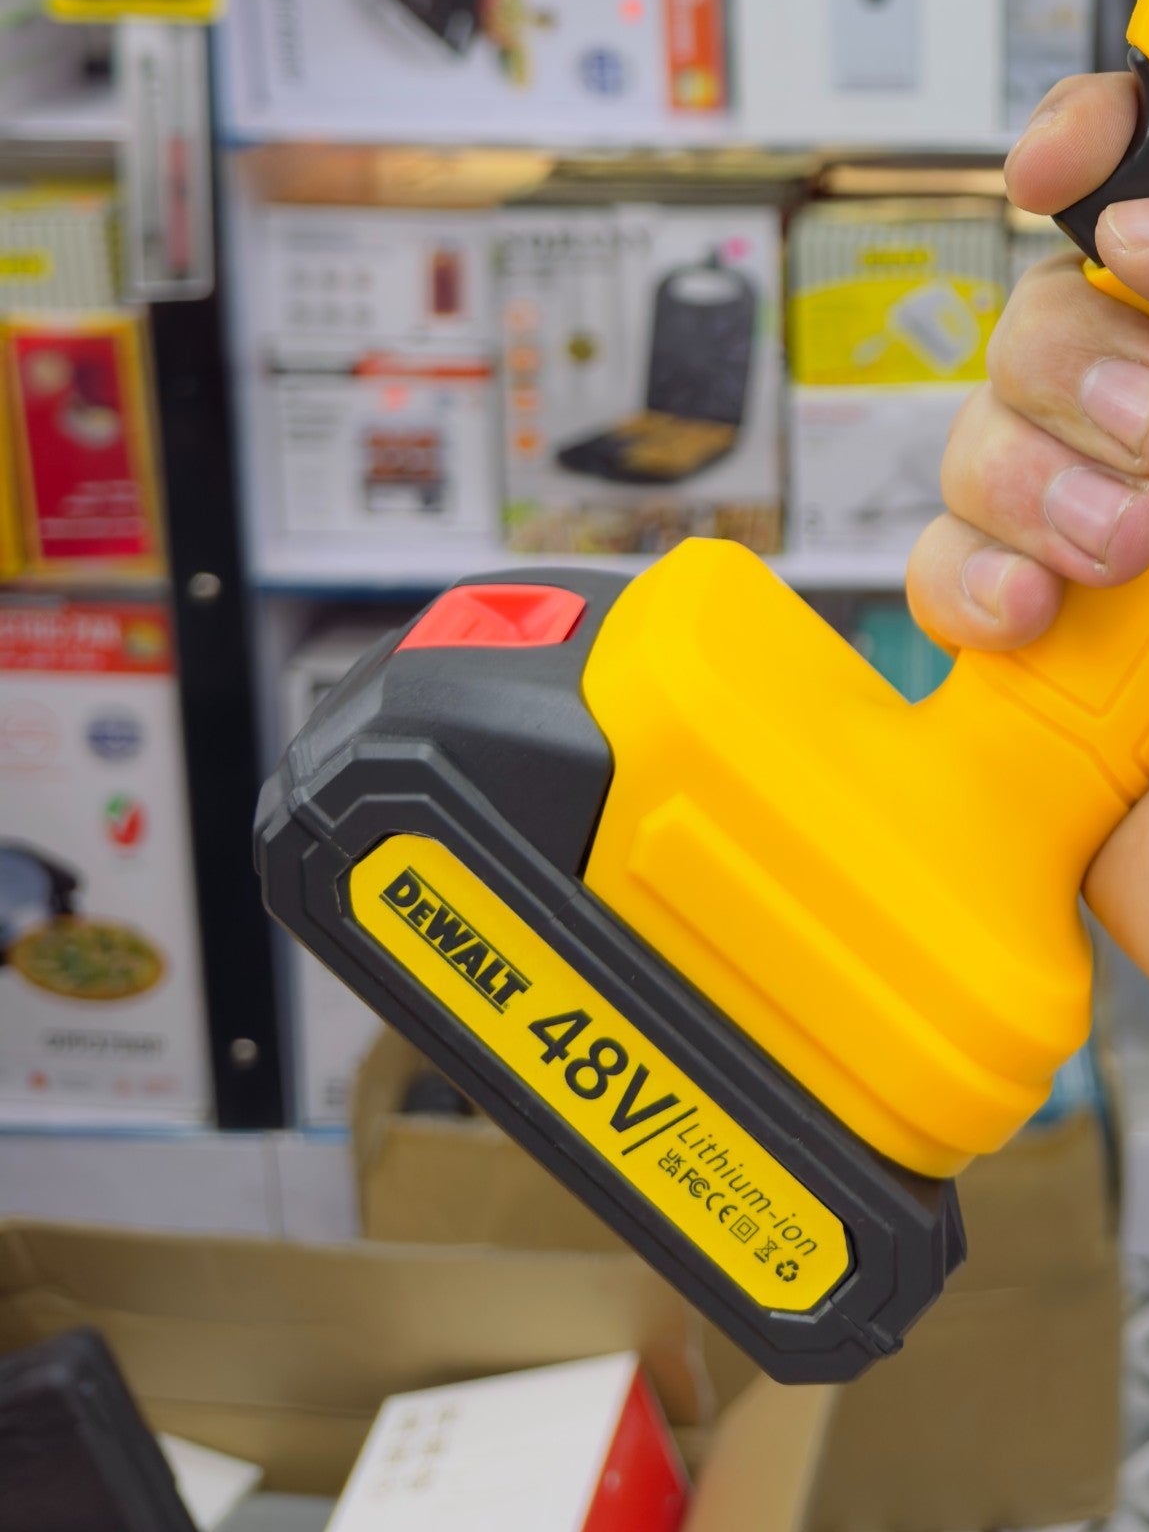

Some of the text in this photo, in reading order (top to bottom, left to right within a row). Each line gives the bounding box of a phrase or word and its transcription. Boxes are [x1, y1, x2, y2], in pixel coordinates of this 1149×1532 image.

[657, 1159, 679, 1178] CA
[665, 1148, 687, 1169] UK
[676, 1123, 818, 1257] Lithium-ion
